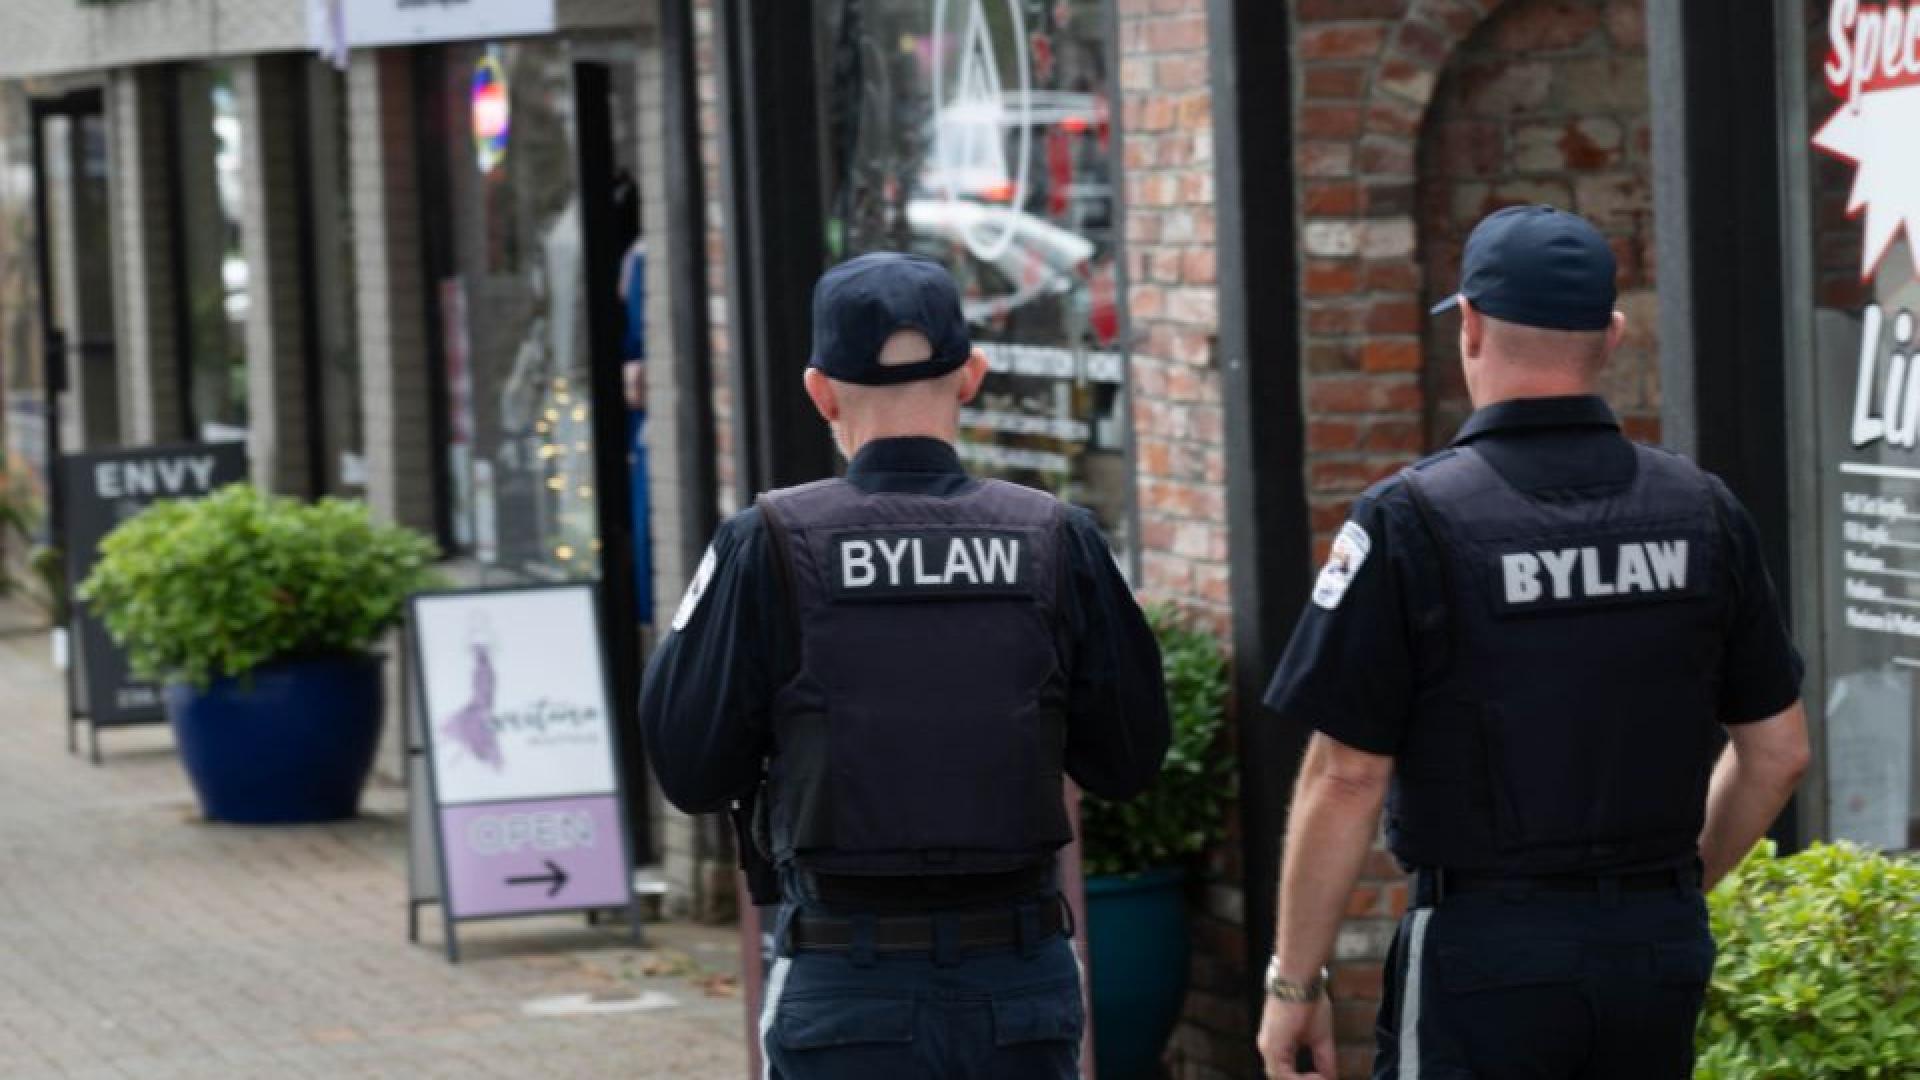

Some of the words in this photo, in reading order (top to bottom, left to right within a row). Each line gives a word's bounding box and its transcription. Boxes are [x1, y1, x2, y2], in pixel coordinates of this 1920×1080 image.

[95, 457, 216, 498] ENVY
[840, 537, 1020, 588] BYLAW
[1502, 539, 1688, 603] BYLAW
[466, 813, 594, 854] OPEN
